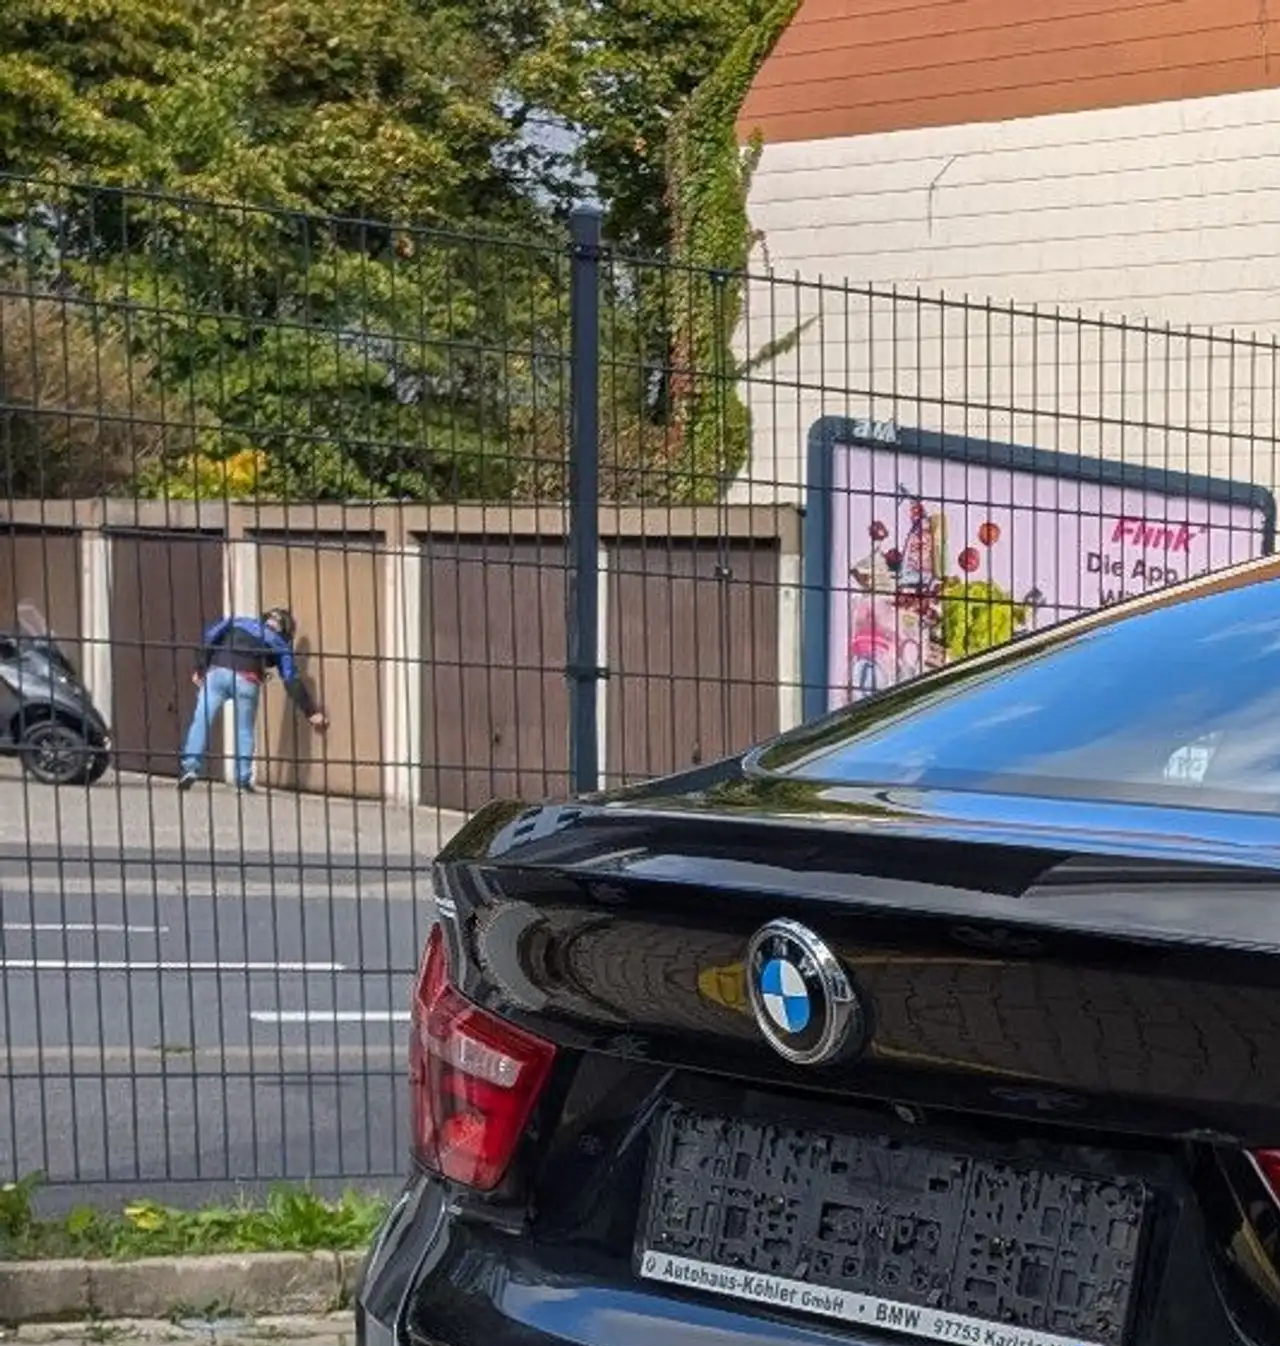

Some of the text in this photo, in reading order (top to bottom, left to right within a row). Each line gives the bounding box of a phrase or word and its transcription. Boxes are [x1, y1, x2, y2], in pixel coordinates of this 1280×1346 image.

[1087, 552, 1123, 577] Die
[662, 1259, 798, 1302] Autohaus-Köhler
[801, 1290, 844, 1313] GmbH
[875, 1302, 921, 1329] BMW
[933, 1319, 980, 1343] 97753
